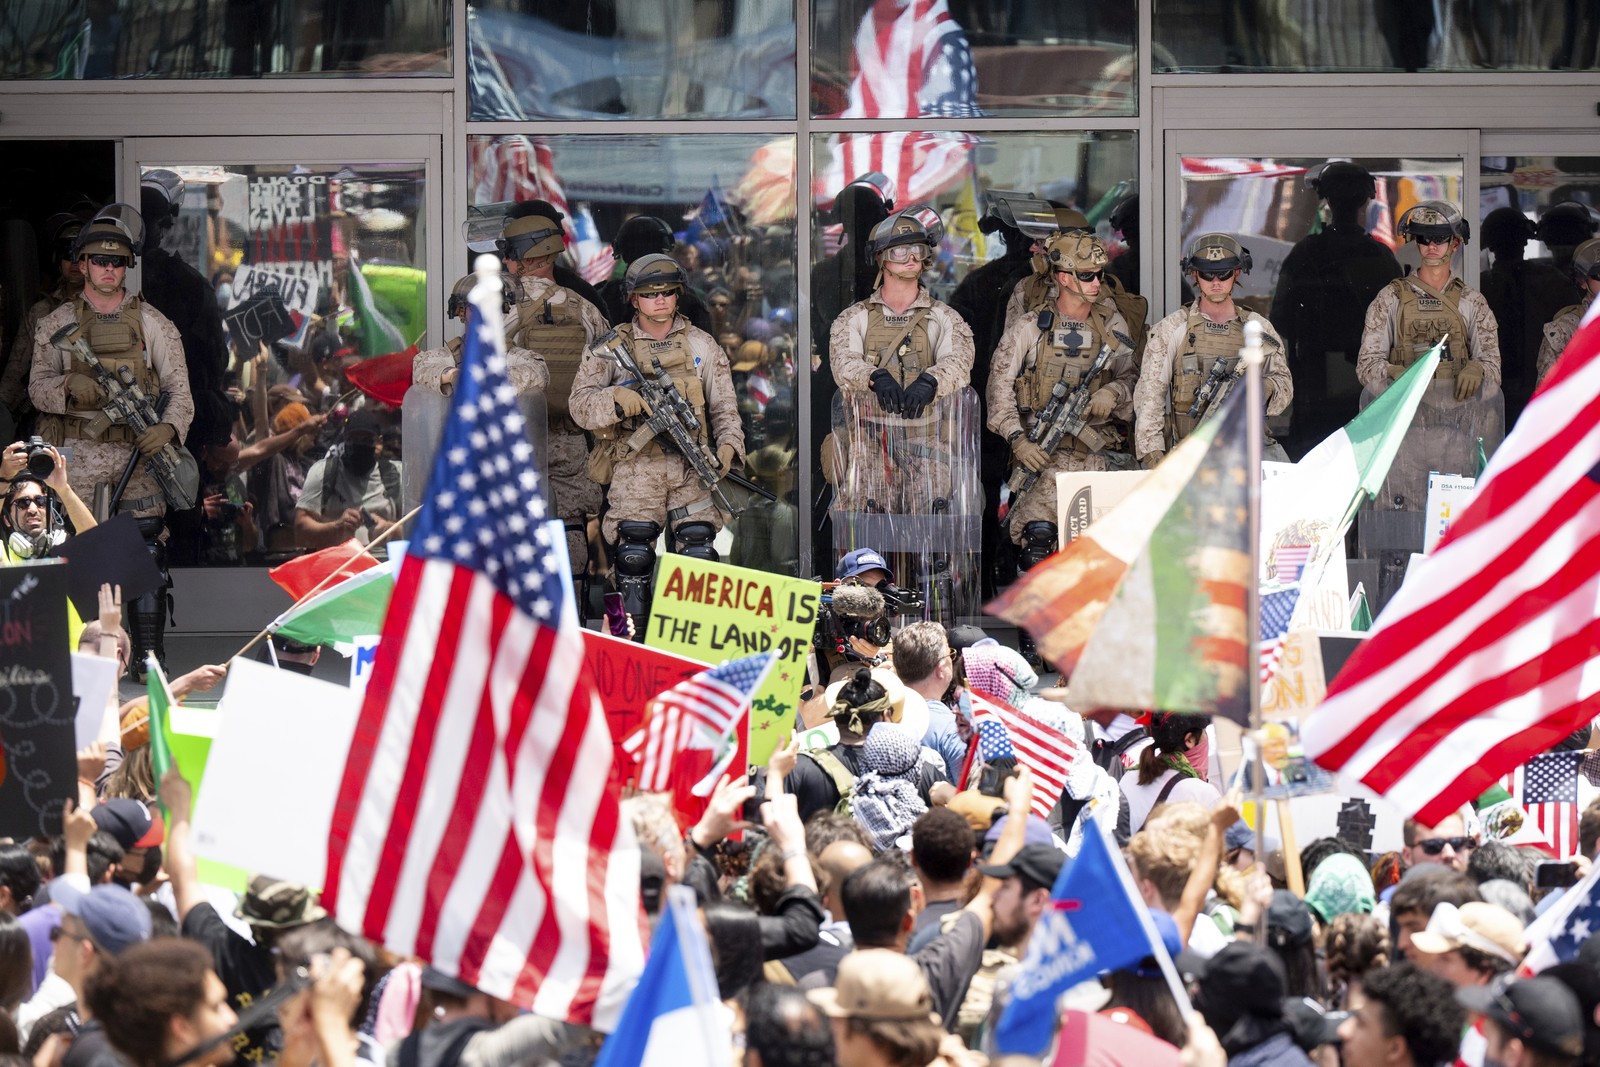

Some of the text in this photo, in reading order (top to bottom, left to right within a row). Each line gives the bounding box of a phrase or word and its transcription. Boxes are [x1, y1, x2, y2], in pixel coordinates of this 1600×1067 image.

[1206, 322, 1229, 330] USMC
[650, 340, 673, 348] USMC
[663, 566, 817, 624] AMERICA IS
[1298, 589, 1344, 631] AND
[653, 613, 808, 663] THE LAND OF
[752, 694, 791, 717] nts
